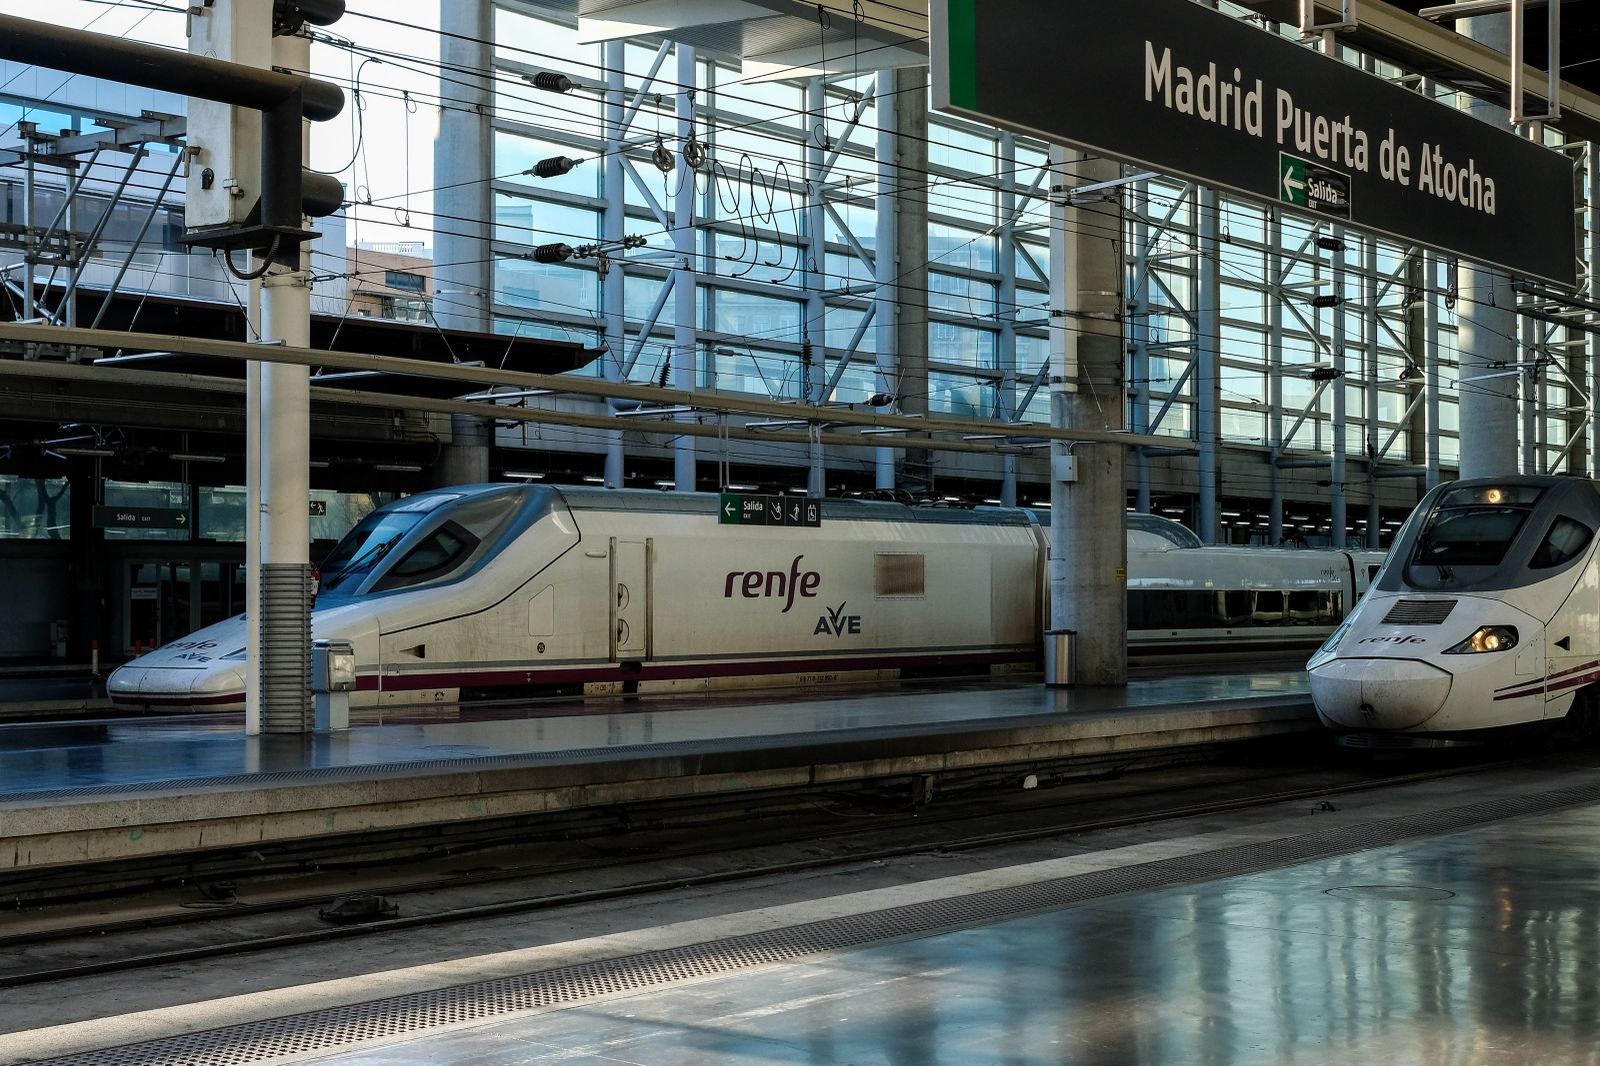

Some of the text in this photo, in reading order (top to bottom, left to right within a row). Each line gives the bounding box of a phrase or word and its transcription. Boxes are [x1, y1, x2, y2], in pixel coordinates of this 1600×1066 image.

[1145, 39, 1496, 216] Madrid Puerta de Atocha
[1308, 177, 1338, 204] Salida
[116, 512, 136, 522] Salida
[742, 500, 764, 512] Salida
[724, 555, 821, 613] renfe
[813, 600, 861, 639] AVE
[1358, 634, 1426, 645] renfe
